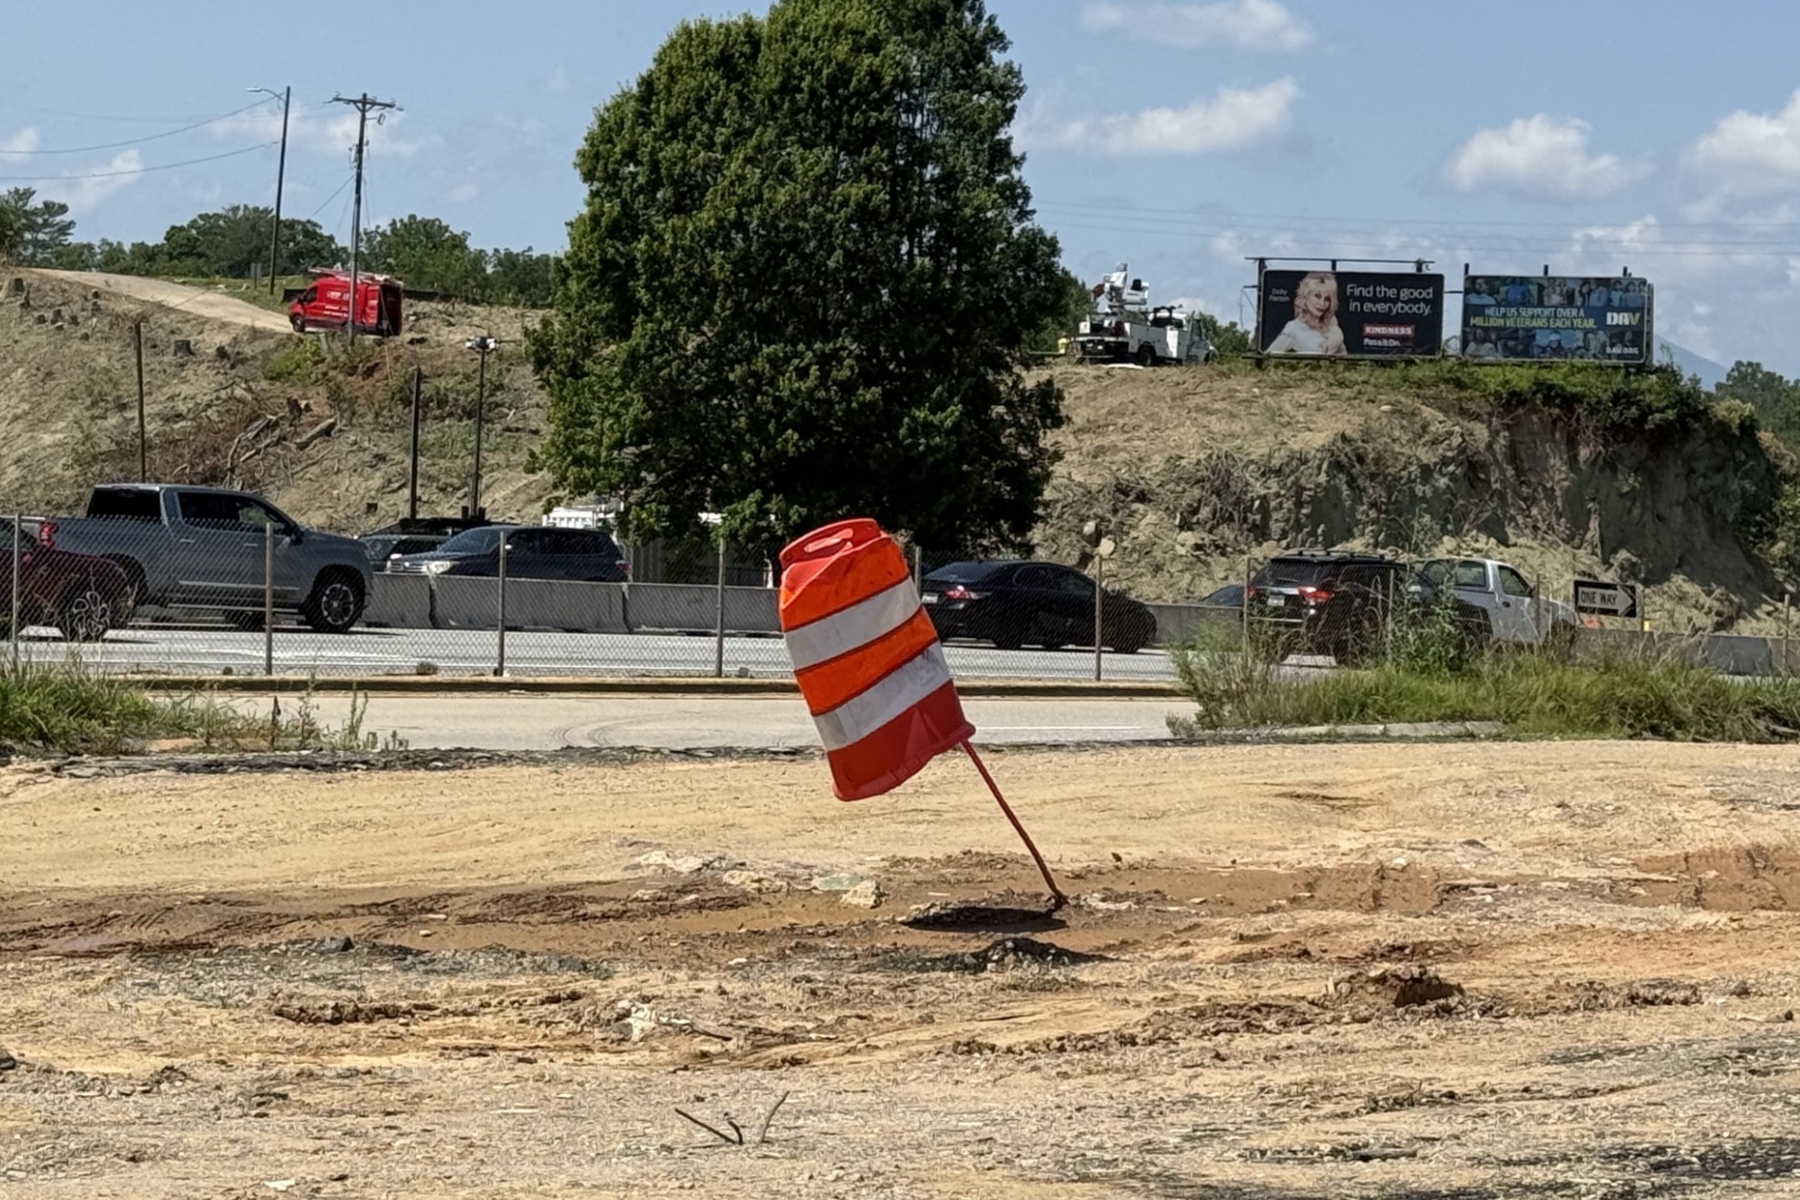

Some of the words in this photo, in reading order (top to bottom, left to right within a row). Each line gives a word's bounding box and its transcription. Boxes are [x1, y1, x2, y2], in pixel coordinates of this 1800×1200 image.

[1346, 284, 1374, 298] Find
[1376, 285, 1398, 298] the
[1400, 287, 1433, 301] good
[1363, 301, 1432, 316] everybody.
[1484, 307, 1505, 317] HELP
[1506, 307, 1518, 317] US
[1519, 307, 1555, 317] SUPPORT
[1556, 308, 1578, 317] OVER
[1579, 308, 1585, 317] A
[1470, 316, 1505, 327] MILLION
[1506, 317, 1548, 328] VETERANS
[1550, 318, 1571, 328] EACH
[1606, 311, 1640, 326] DAV
[1365, 327, 1412, 335] KINDNESS
[1580, 590, 1596, 604] ONE
[1600, 592, 1617, 606] WAY
